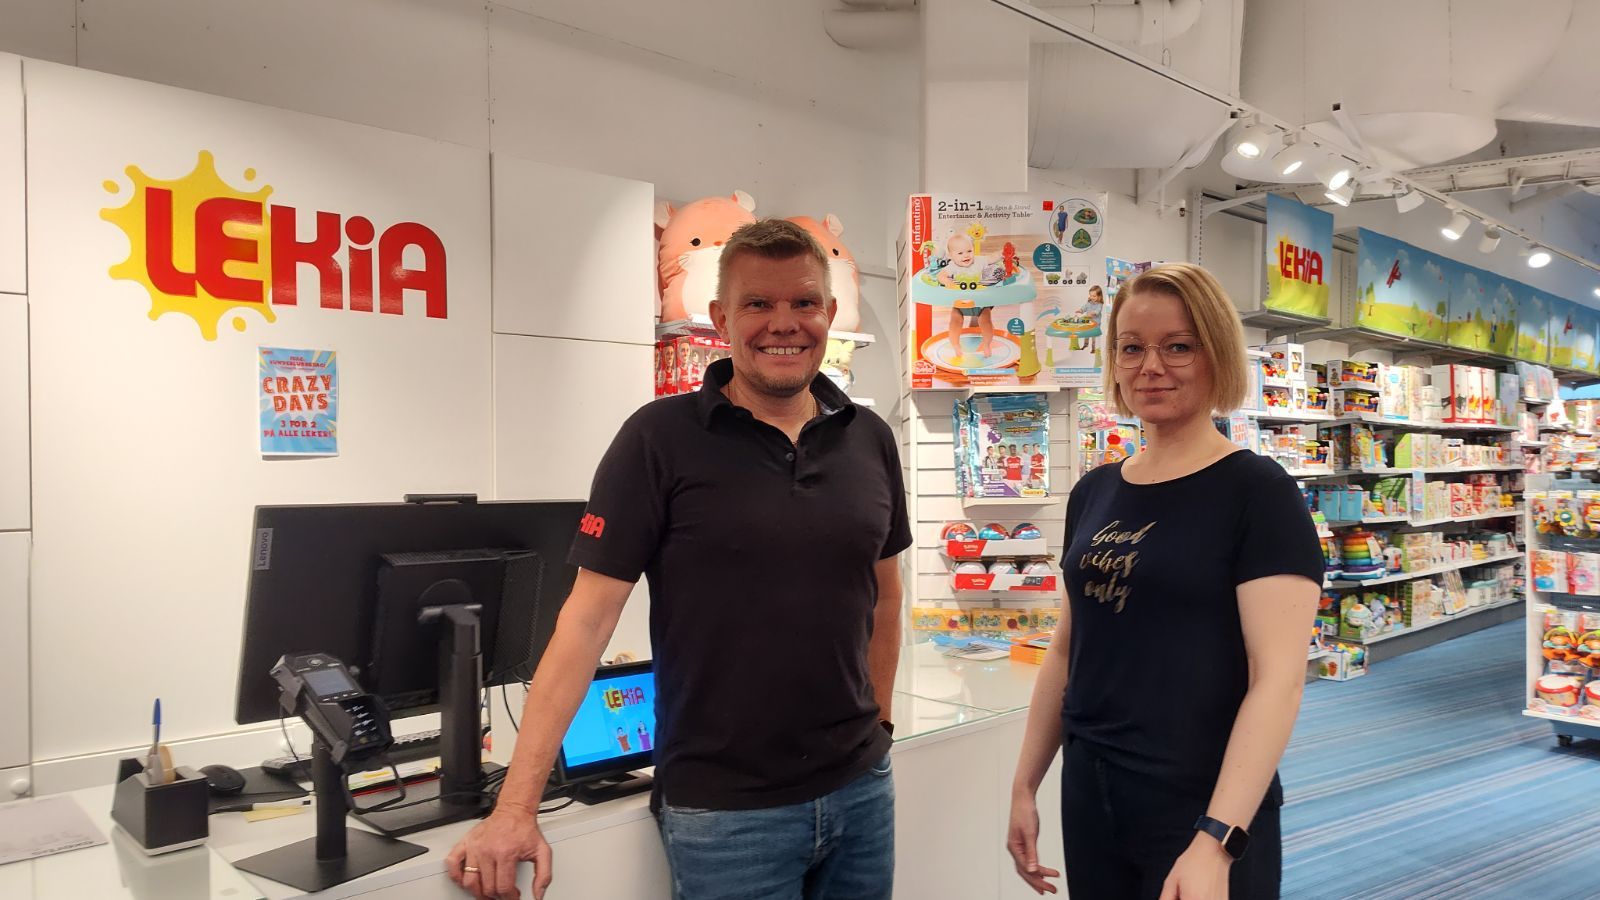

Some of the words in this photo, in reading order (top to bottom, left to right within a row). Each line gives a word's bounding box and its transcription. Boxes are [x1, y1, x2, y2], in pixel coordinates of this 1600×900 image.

[938, 198, 983, 212] 2-in-1
[913, 197, 921, 245] infantino
[938, 212, 976, 220] Entertainer
[984, 211, 1011, 220] Activity
[1045, 244, 1051, 252] 3
[262, 374, 332, 394] CRAZY
[273, 393, 328, 412] DAYS
[281, 420, 286, 428] 3
[290, 420, 308, 428] FOR
[1090, 520, 1158, 547] Good
[257, 531, 269, 567] Lenovo
[1079, 549, 1141, 578] vibes
[1084, 570, 1132, 613] only
